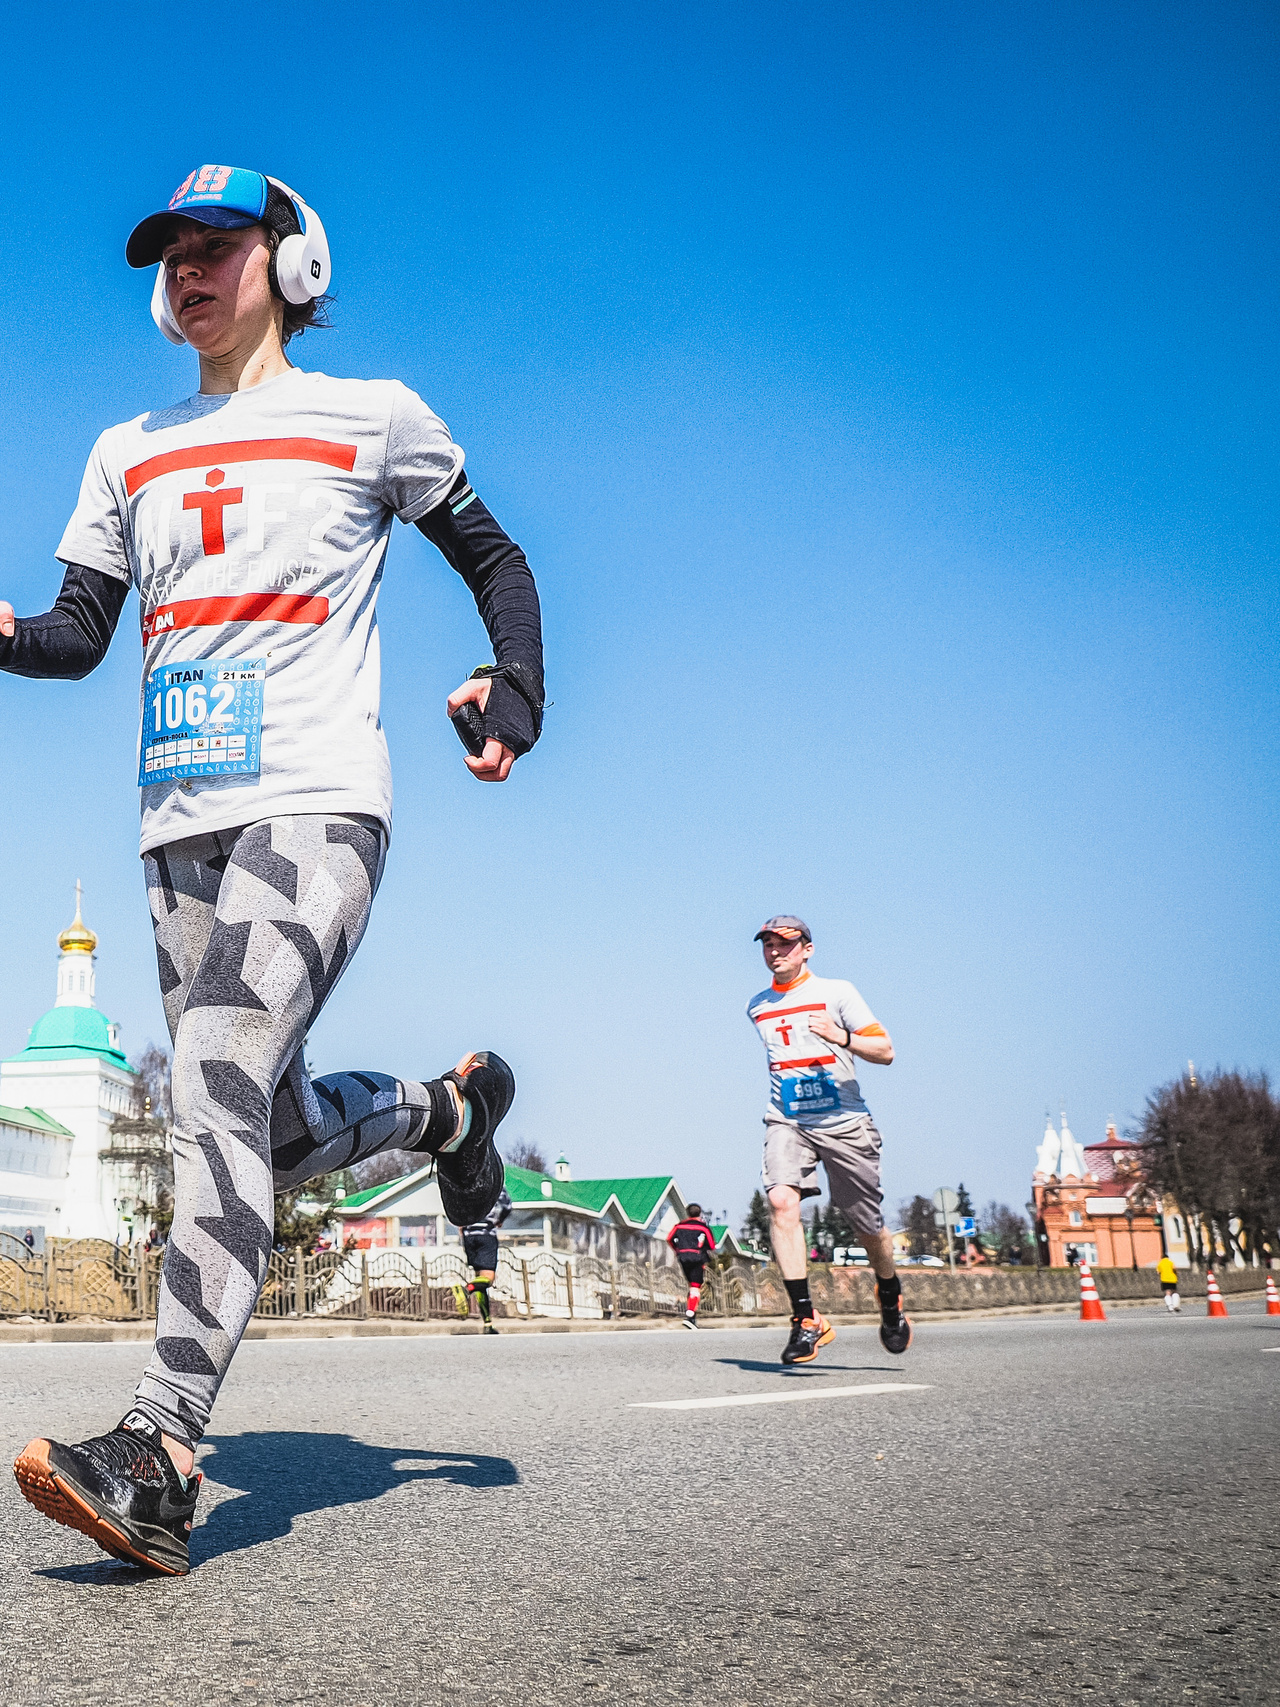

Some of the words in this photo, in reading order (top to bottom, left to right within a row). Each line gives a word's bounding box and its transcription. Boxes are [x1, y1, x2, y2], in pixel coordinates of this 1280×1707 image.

[202, 561, 239, 591] THE
[223, 672, 235, 681] 21
[153, 683, 235, 732] 1062
[794, 1082, 823, 1098] 996
